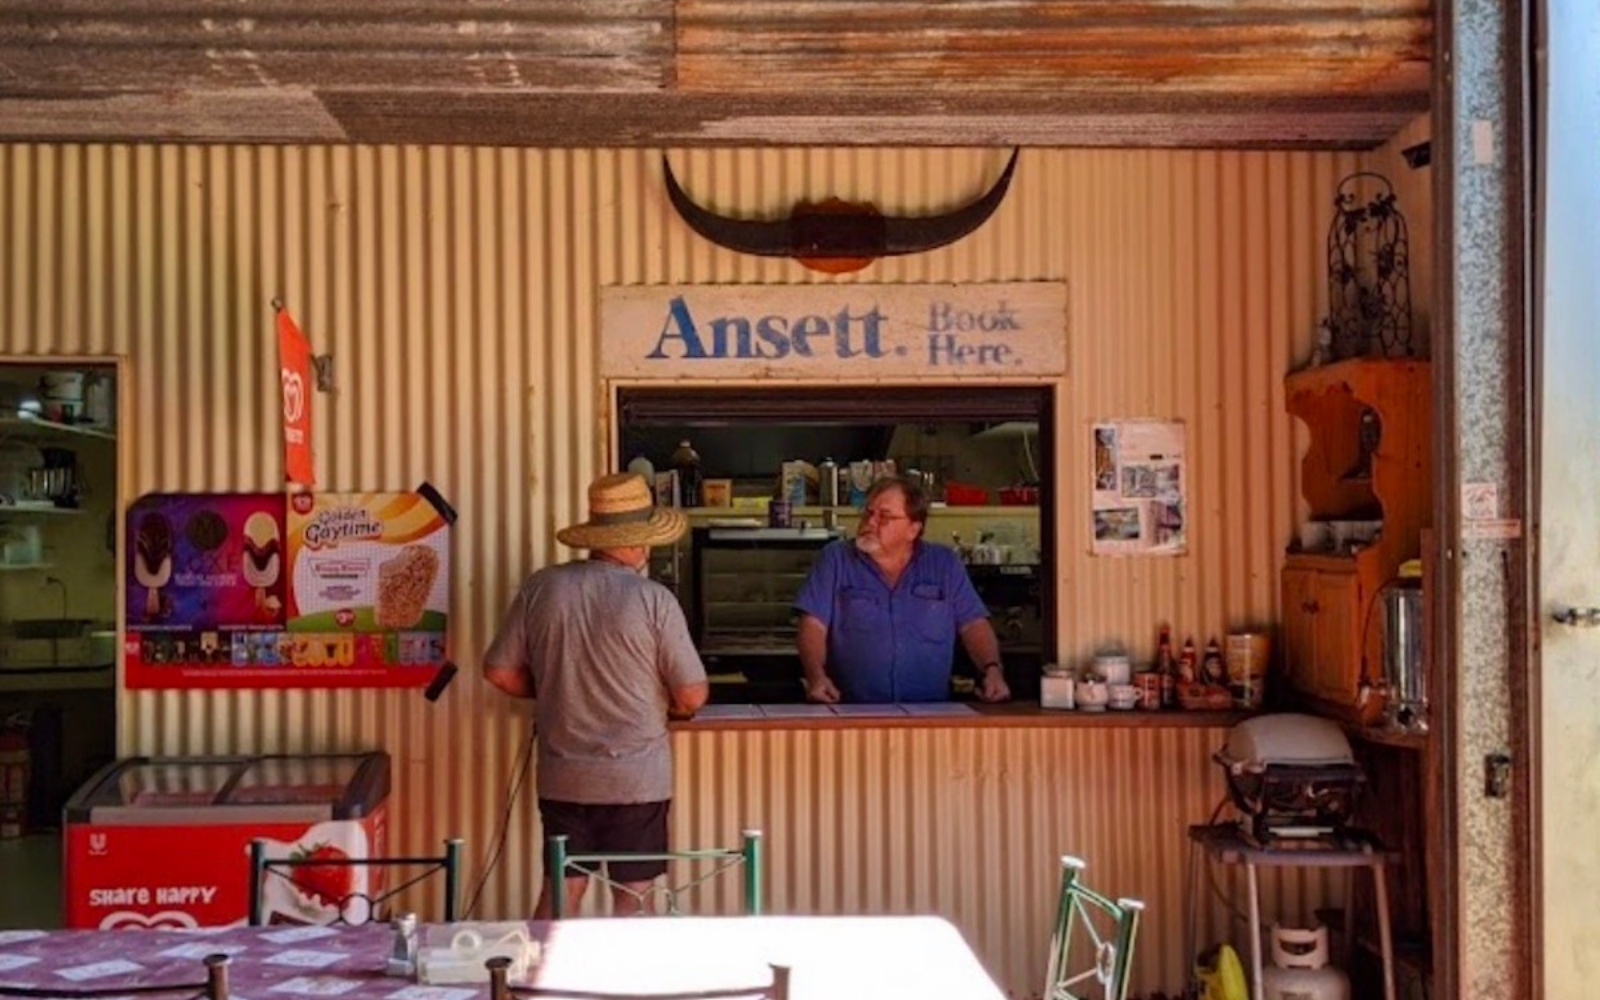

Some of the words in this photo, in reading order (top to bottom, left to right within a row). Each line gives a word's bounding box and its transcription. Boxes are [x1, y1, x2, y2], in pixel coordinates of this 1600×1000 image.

[645, 294, 908, 358] Ansett.
[928, 300, 1021, 332] Book
[928, 334, 1023, 366] Here.
[305, 521, 381, 544] Gaytime
